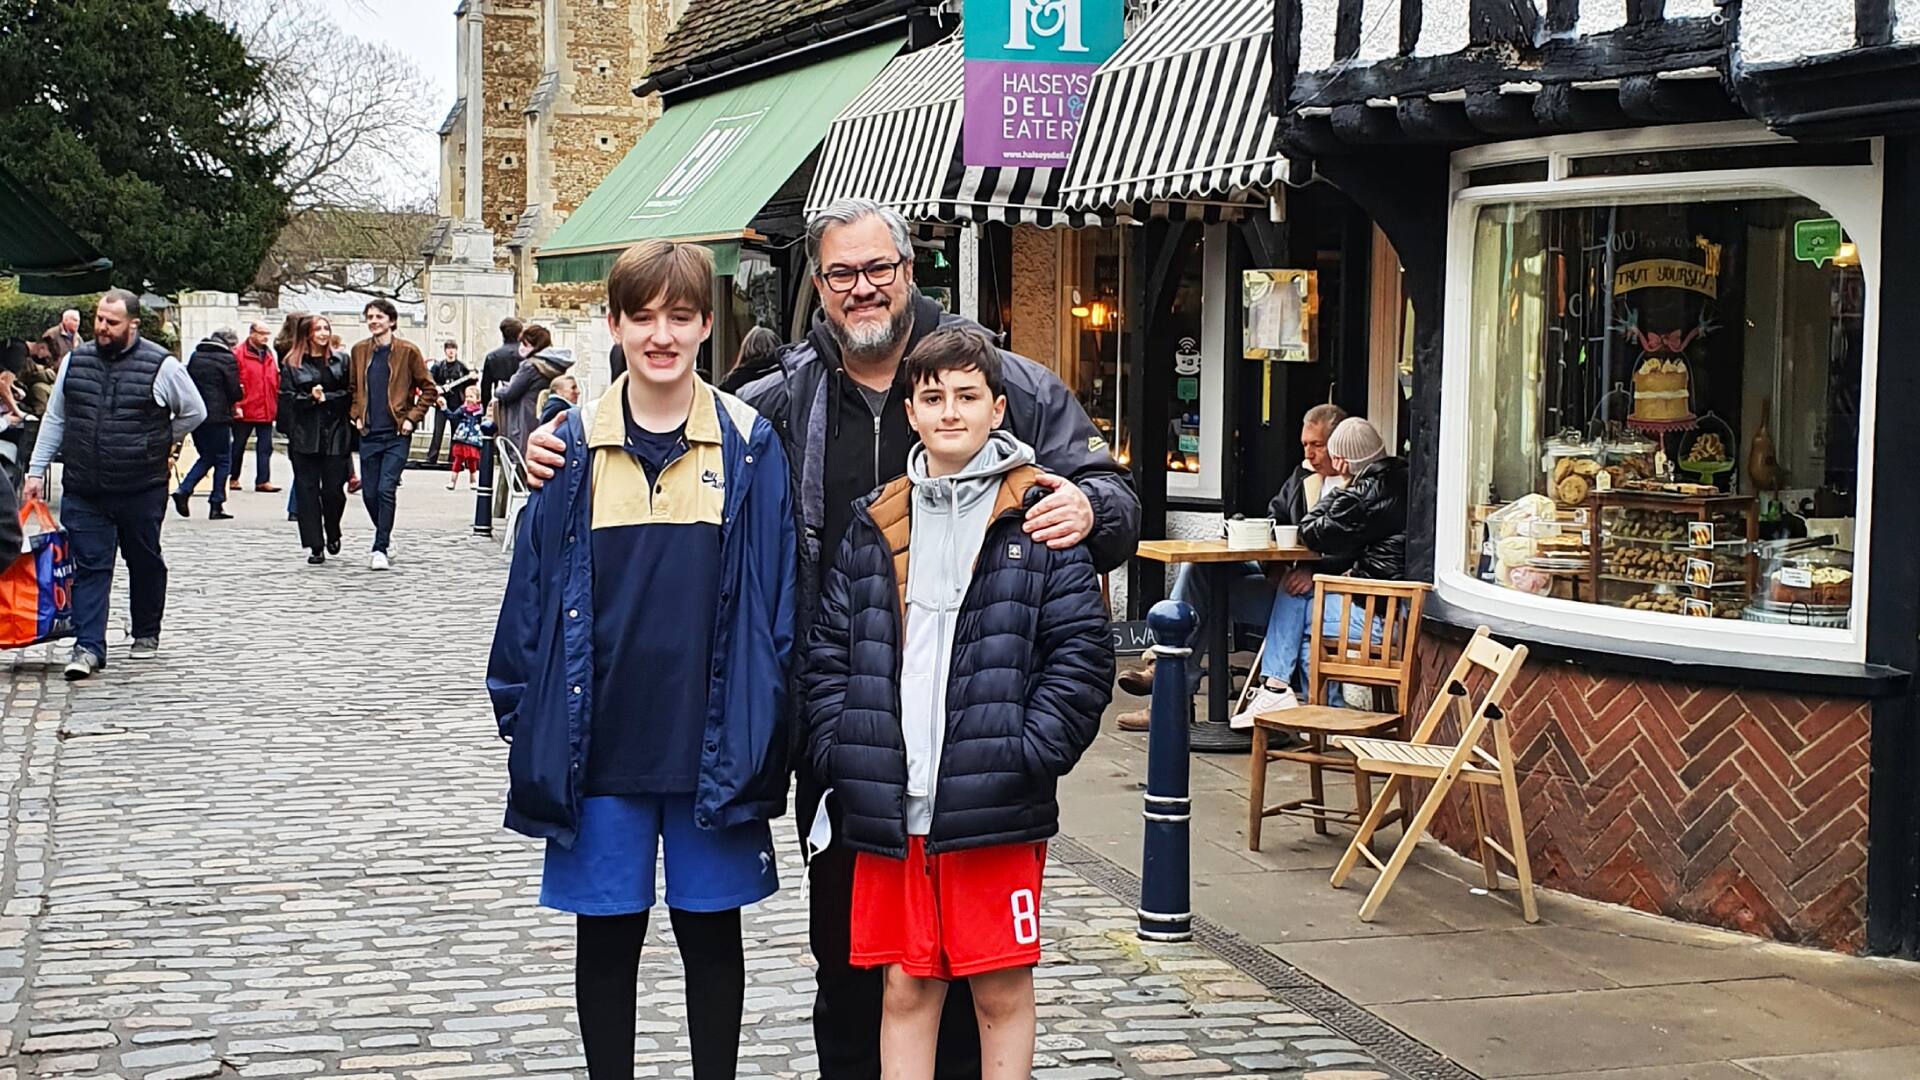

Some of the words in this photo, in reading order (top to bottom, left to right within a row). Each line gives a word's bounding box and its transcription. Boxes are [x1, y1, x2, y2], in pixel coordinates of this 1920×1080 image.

[1003, 72, 1088, 95] HALSEY'S
[1003, 96, 1063, 117] DELI
[1130, 627, 1156, 646] WA
[1011, 889, 1038, 945] 8
